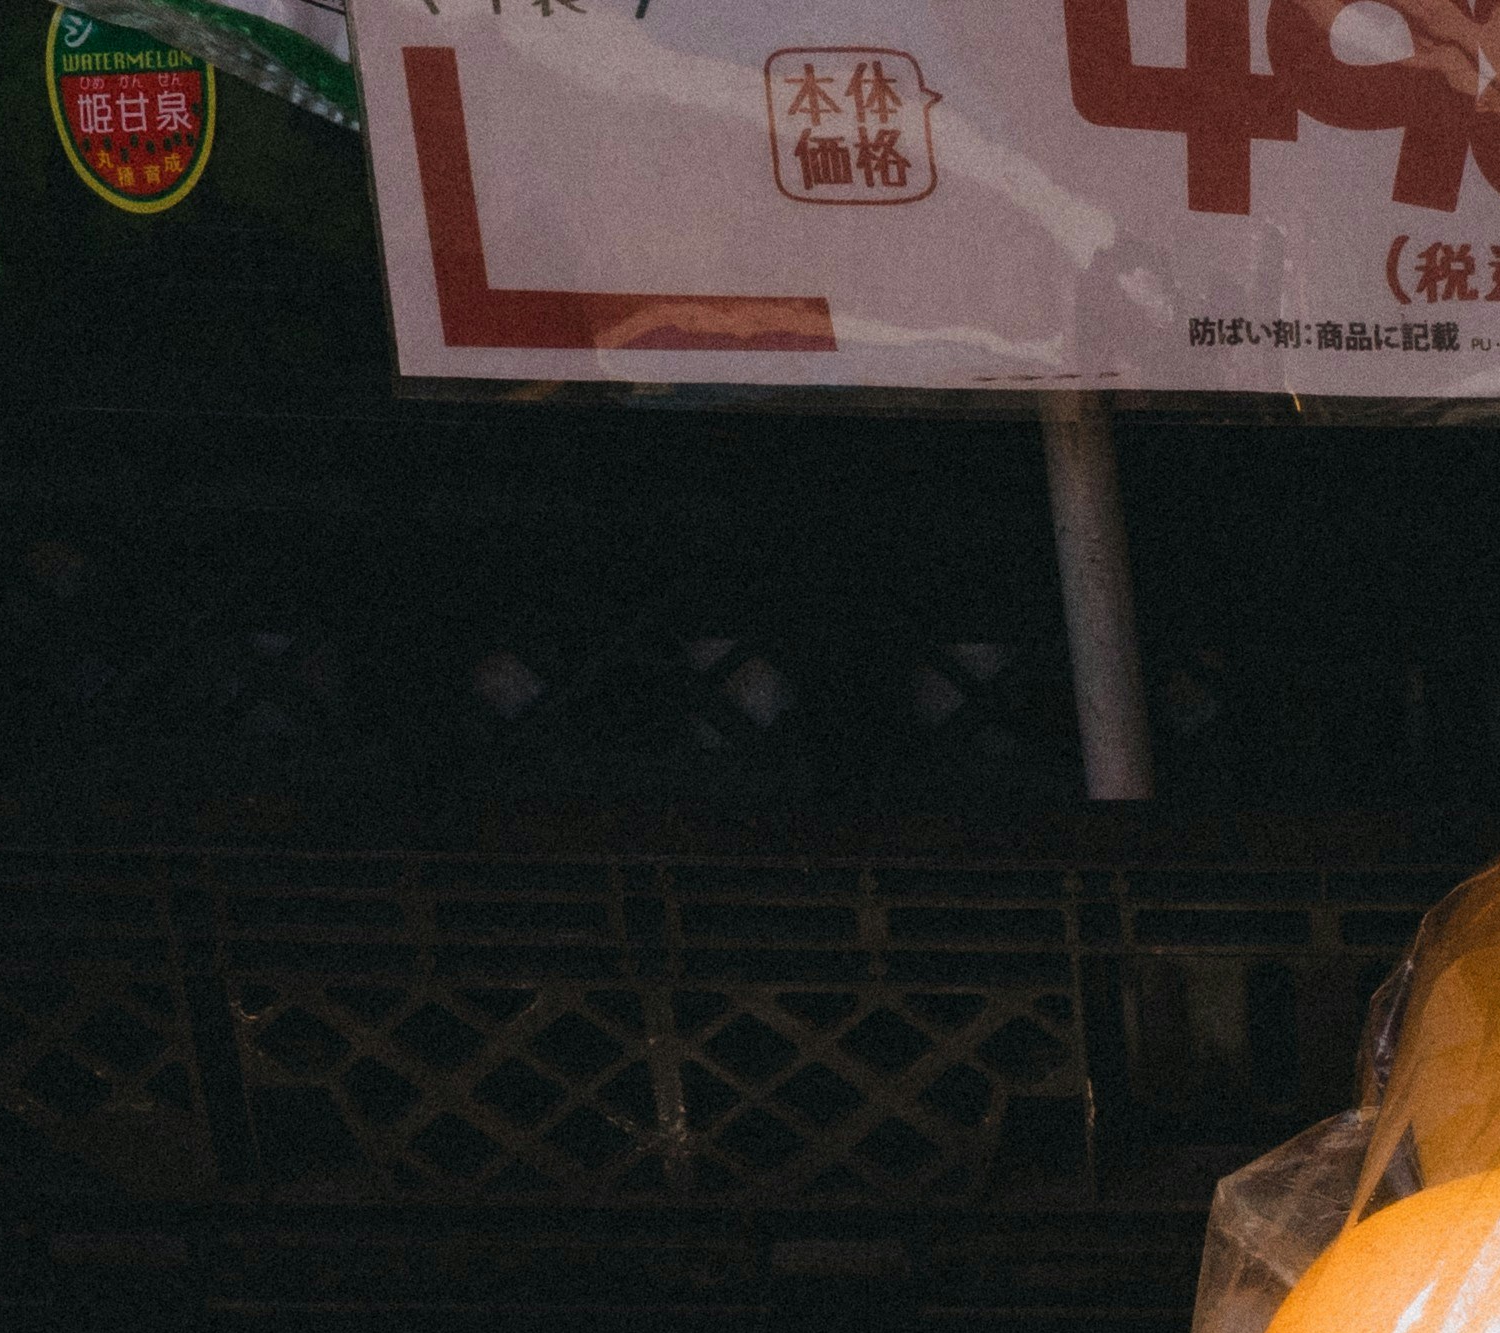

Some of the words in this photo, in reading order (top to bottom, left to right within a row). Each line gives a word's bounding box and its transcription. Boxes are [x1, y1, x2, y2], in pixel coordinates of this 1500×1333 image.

[62, 51, 193, 73] WATERMELON
[77, 90, 193, 134] 姫甘泉
[784, 62, 903, 127] 本体
[792, 128, 911, 190] 価格
